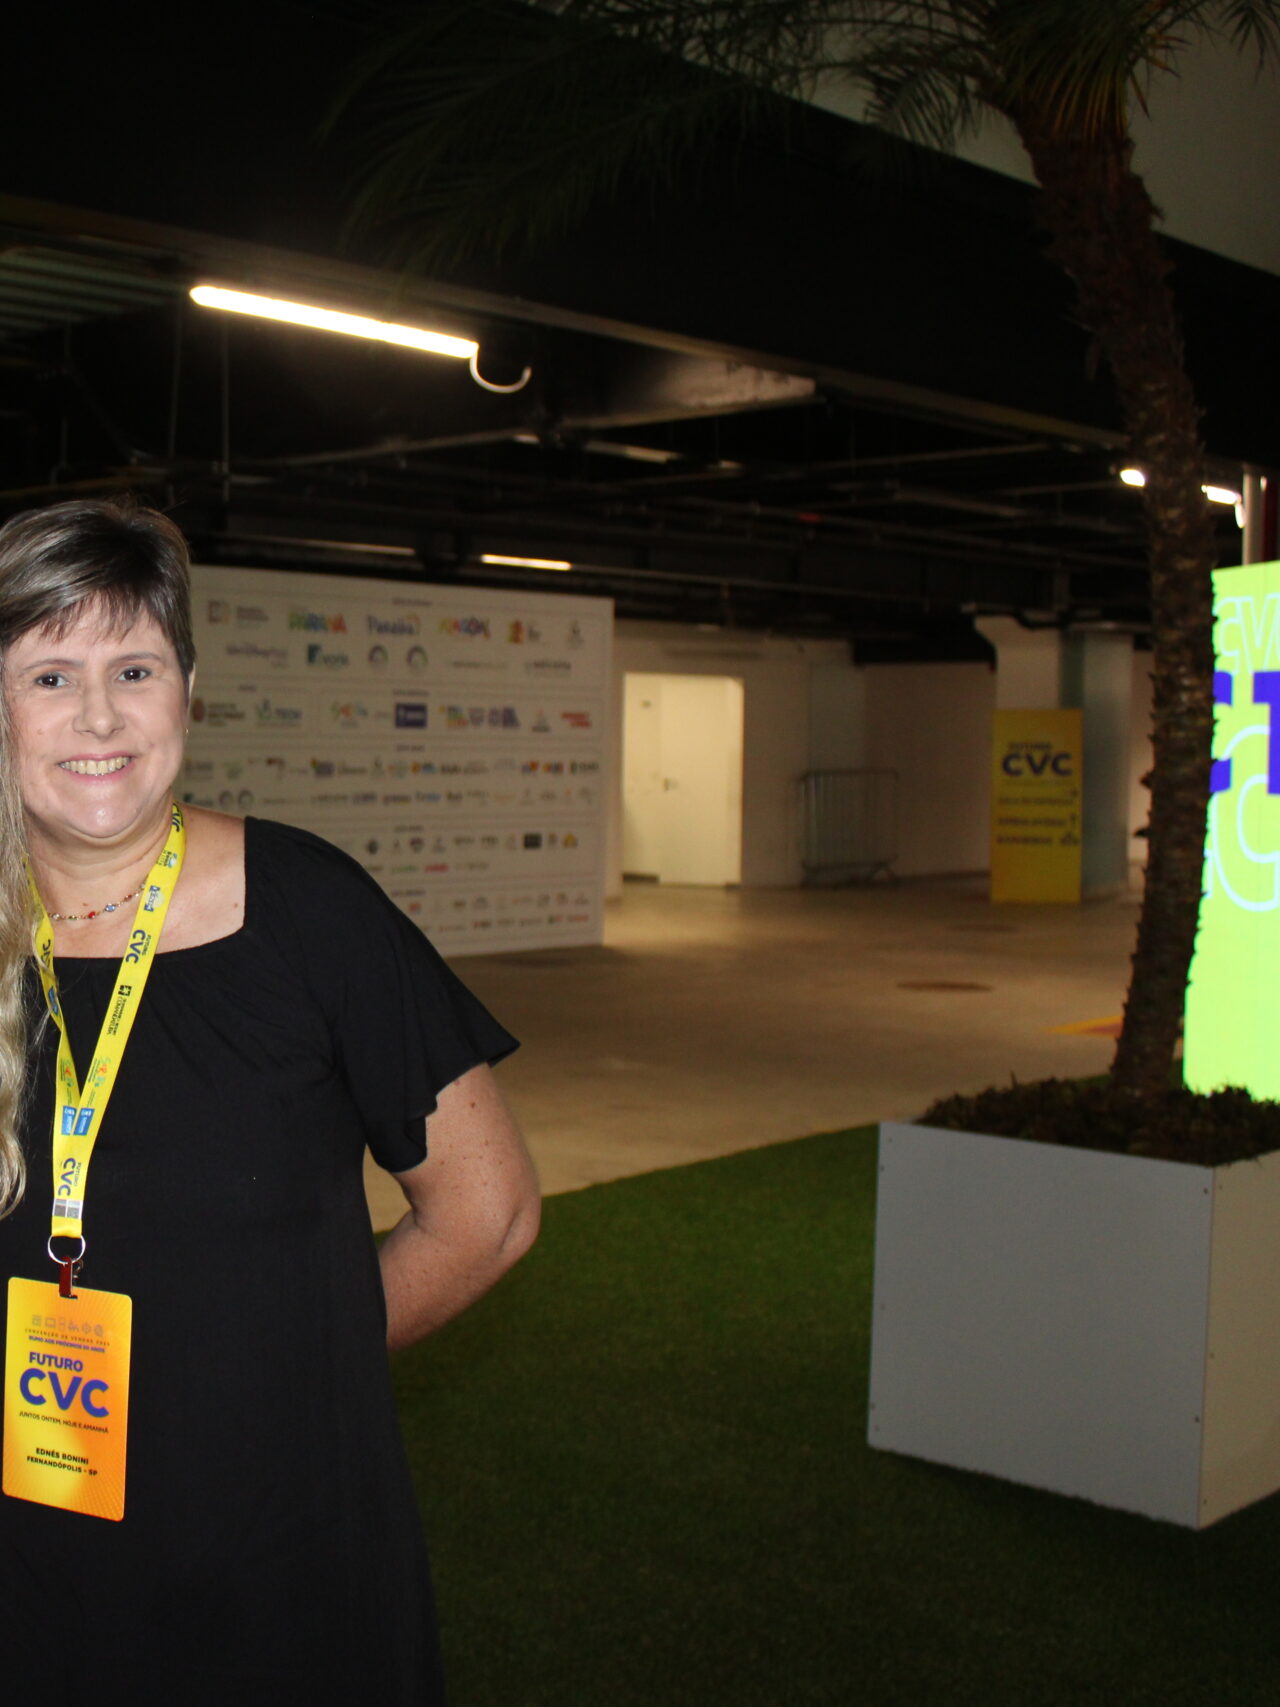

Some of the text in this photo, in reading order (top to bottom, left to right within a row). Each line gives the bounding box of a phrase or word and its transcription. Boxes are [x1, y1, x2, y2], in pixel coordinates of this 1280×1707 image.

[1002, 752, 1074, 776] CVC
[125, 929, 146, 964] CVC
[57, 1157, 77, 1196] CVC
[29, 1352, 83, 1373] FUTURO
[20, 1368, 109, 1418] CVC
[19, 1410, 40, 1420] JUNTOS
[27, 1455, 82, 1473] FERNANDÓPOLIS
[36, 1447, 89, 1465] EDNÉS BONINI
